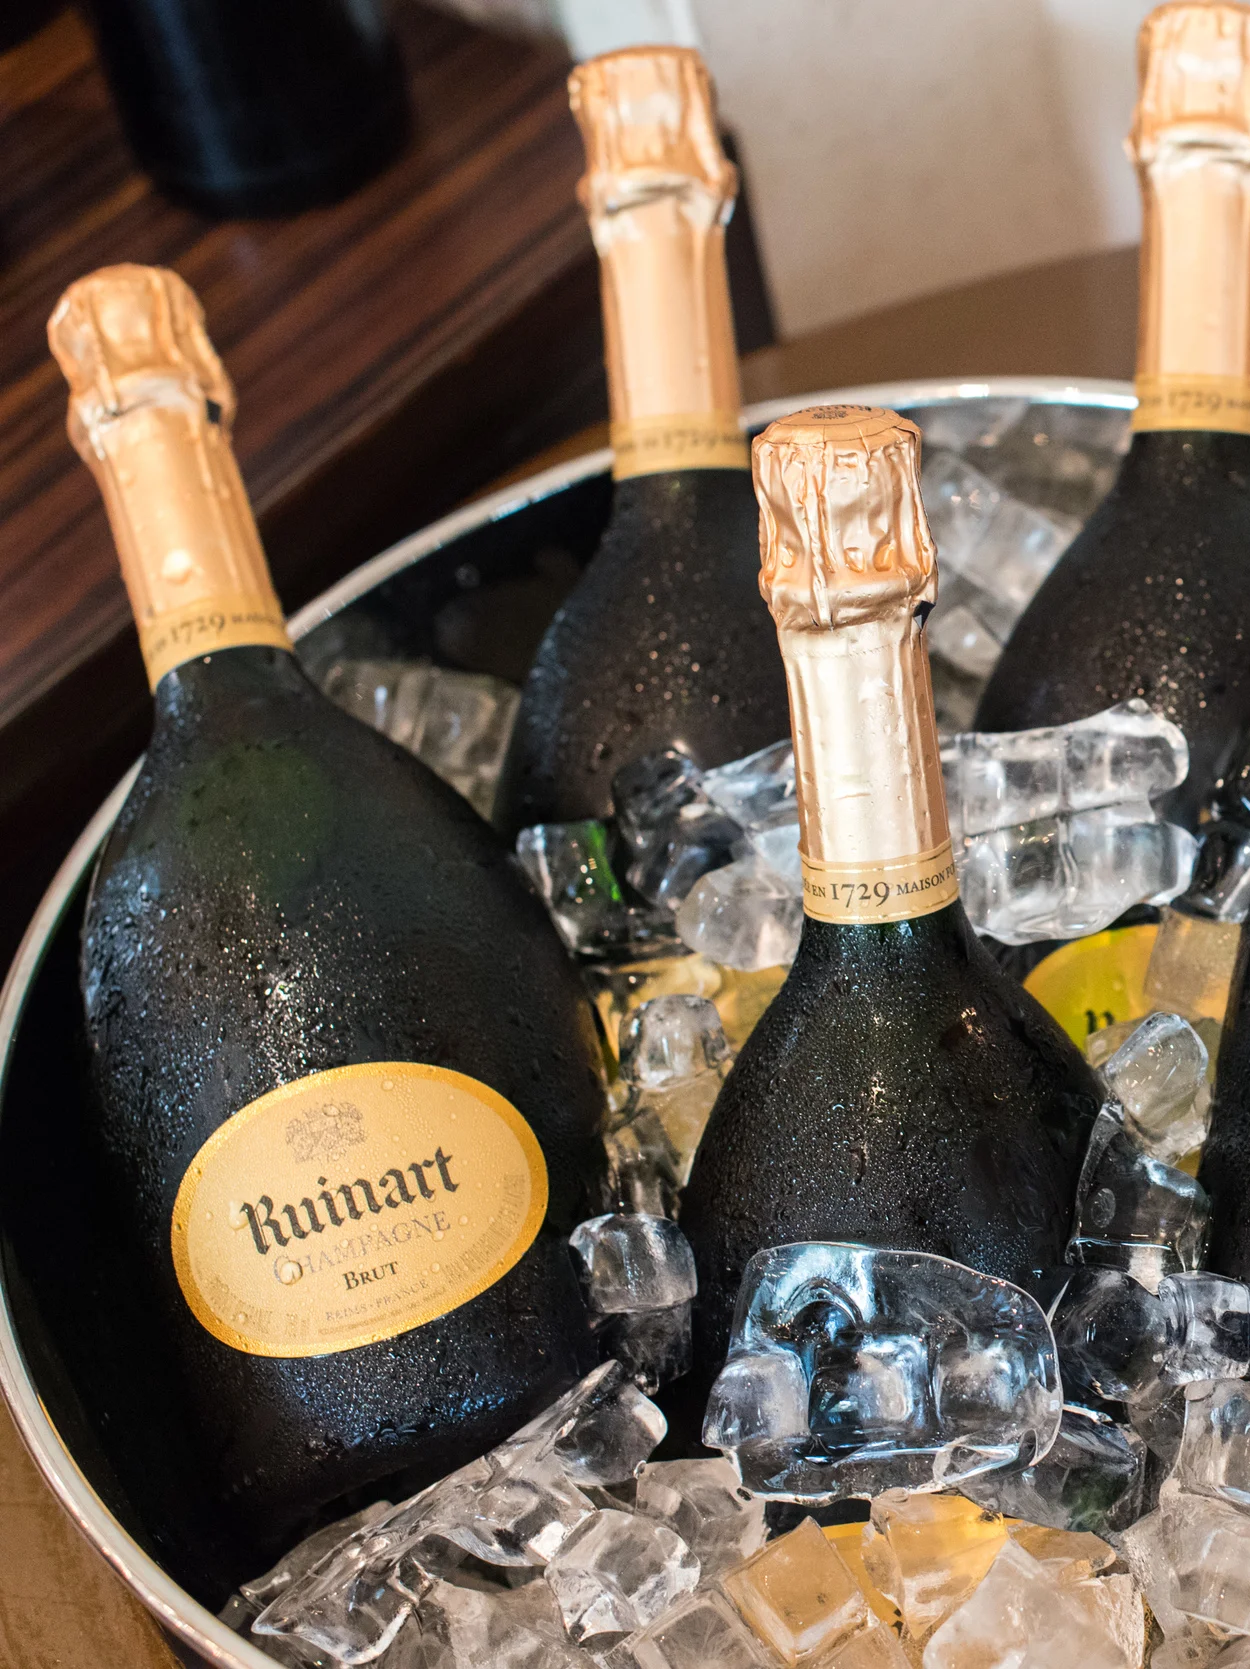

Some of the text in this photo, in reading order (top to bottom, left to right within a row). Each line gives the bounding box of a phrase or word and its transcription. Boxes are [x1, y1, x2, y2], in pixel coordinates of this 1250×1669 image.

[170, 614, 225, 645] 1729
[812, 885, 826, 898] EN
[830, 881, 890, 908] 1729
[897, 870, 945, 896] MAISON
[239, 1146, 460, 1255] Ruinart
